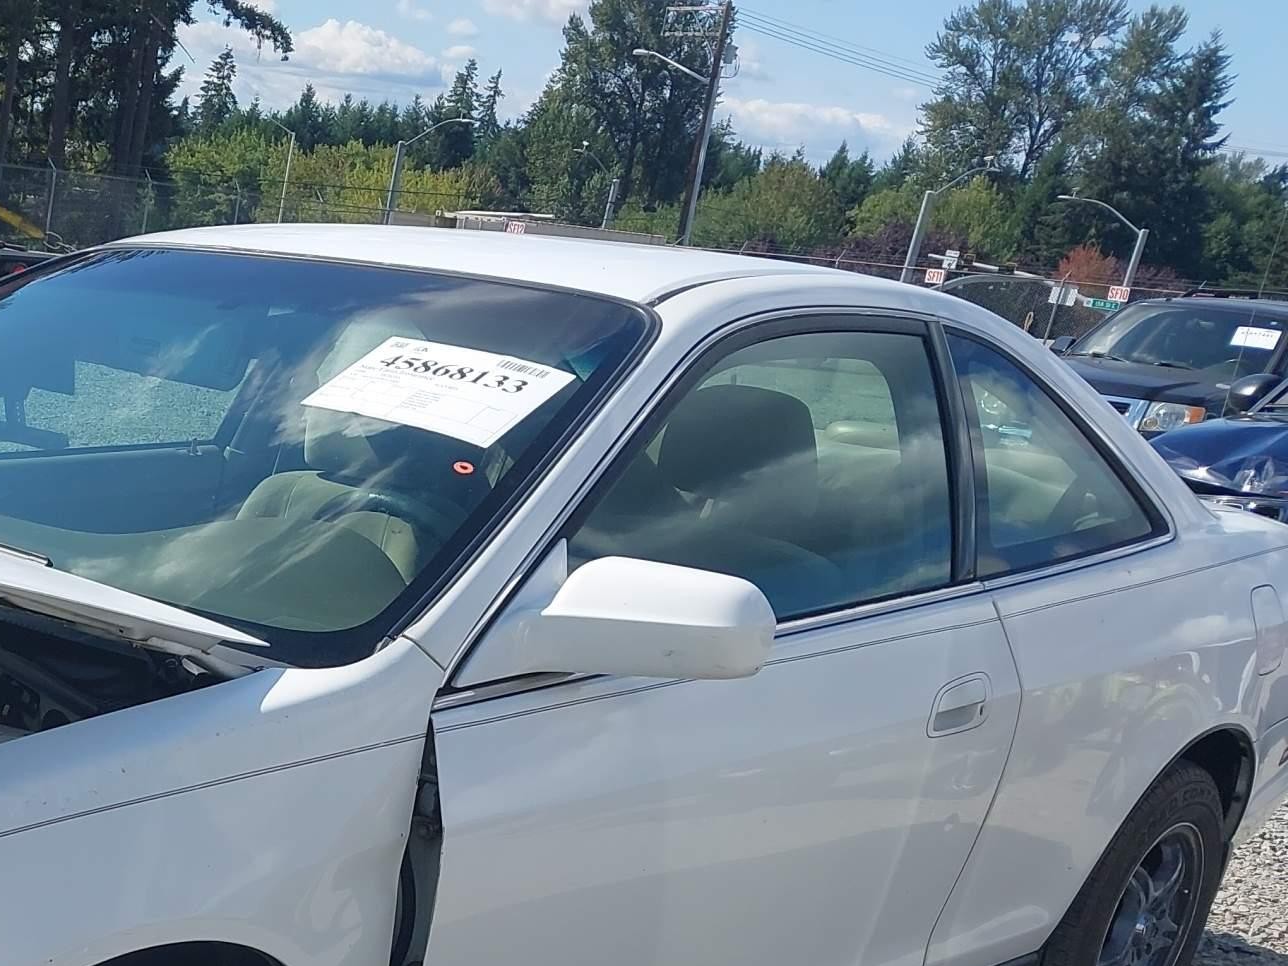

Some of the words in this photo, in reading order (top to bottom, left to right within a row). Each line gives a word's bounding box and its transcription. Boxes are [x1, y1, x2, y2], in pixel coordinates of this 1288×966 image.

[927, 270, 943, 282] SF11
[1108, 287, 1129, 300] SF10
[379, 354, 529, 394] 45868133
